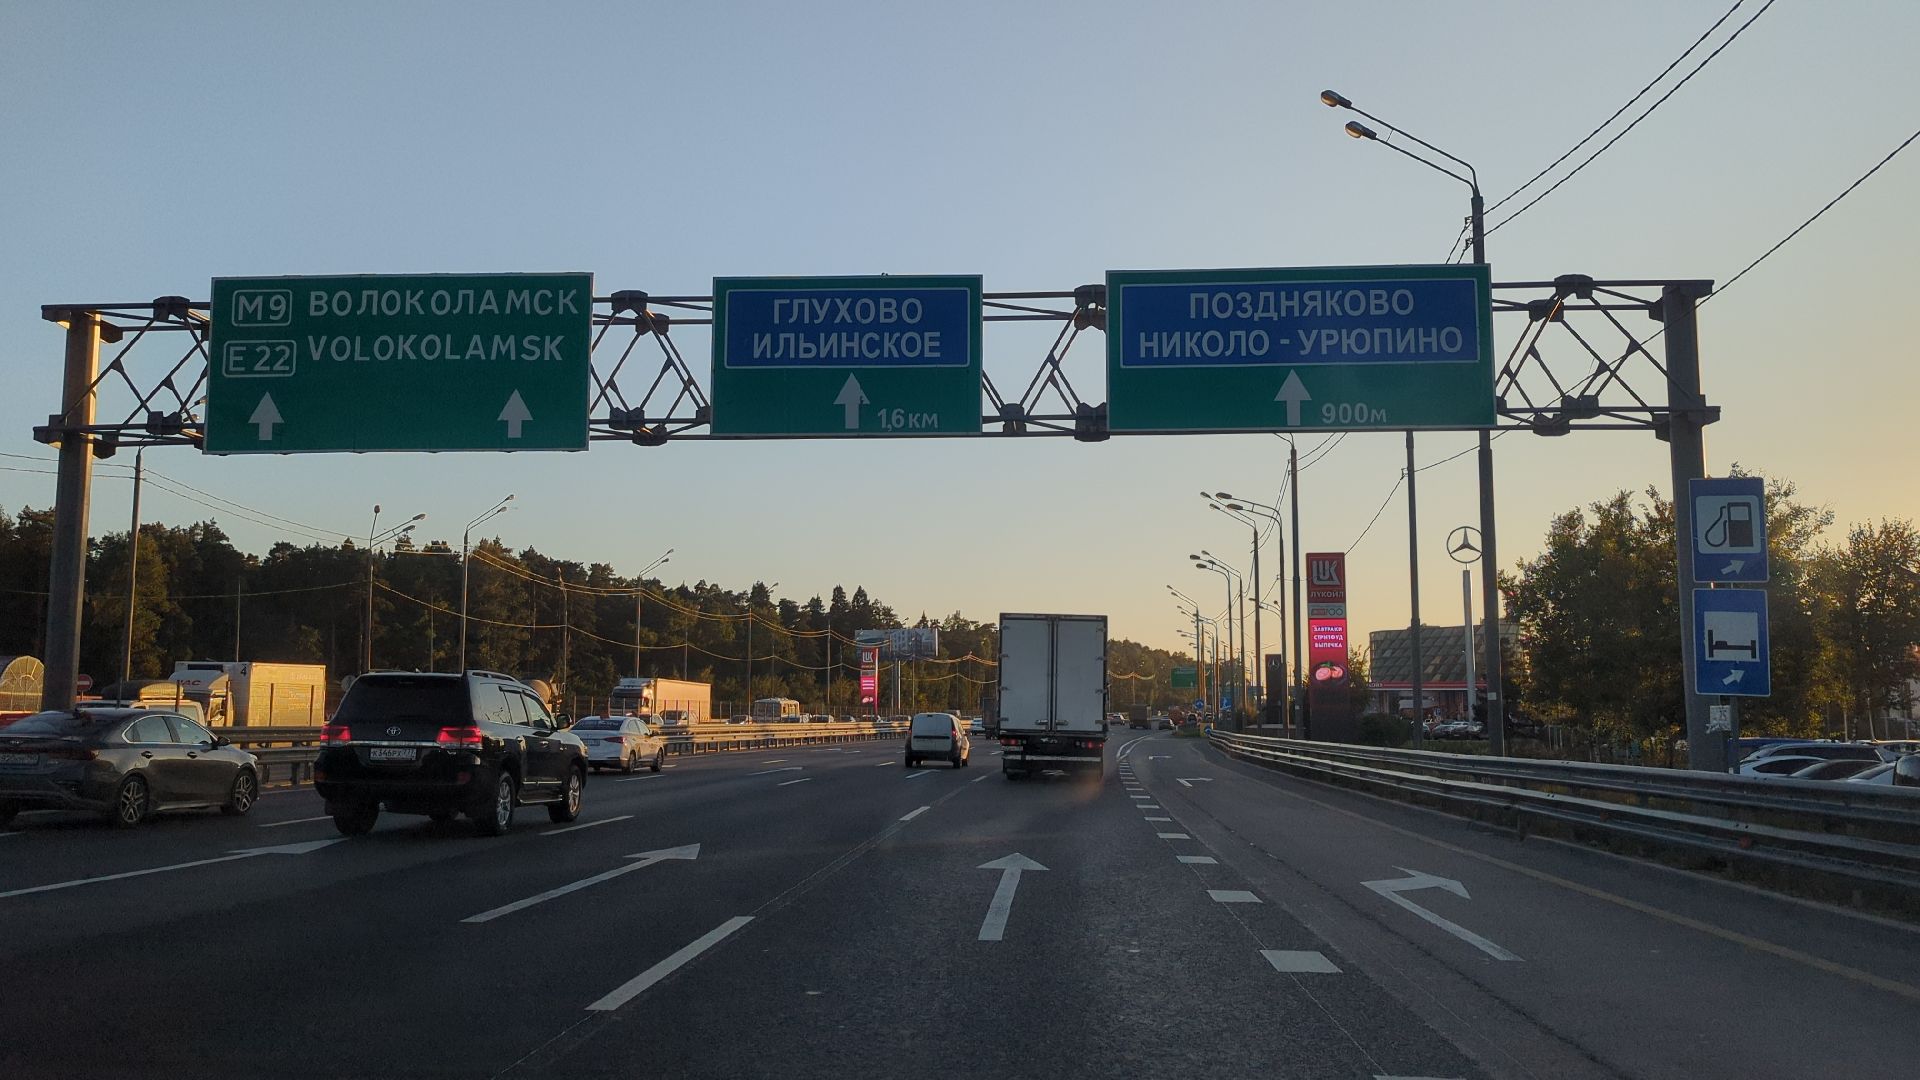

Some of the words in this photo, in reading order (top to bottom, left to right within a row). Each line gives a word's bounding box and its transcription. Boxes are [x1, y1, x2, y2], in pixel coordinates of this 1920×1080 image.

[309, 289, 579, 317] ВОЛОКОЛАМСК
[773, 297, 923, 325] ГЛУХОВО
[1190, 288, 1414, 322] ПОЗДНЯКОВО
[307, 334, 565, 361] VOLOKOLAMSK
[753, 331, 941, 359] ИЛЬИНСКОЕ
